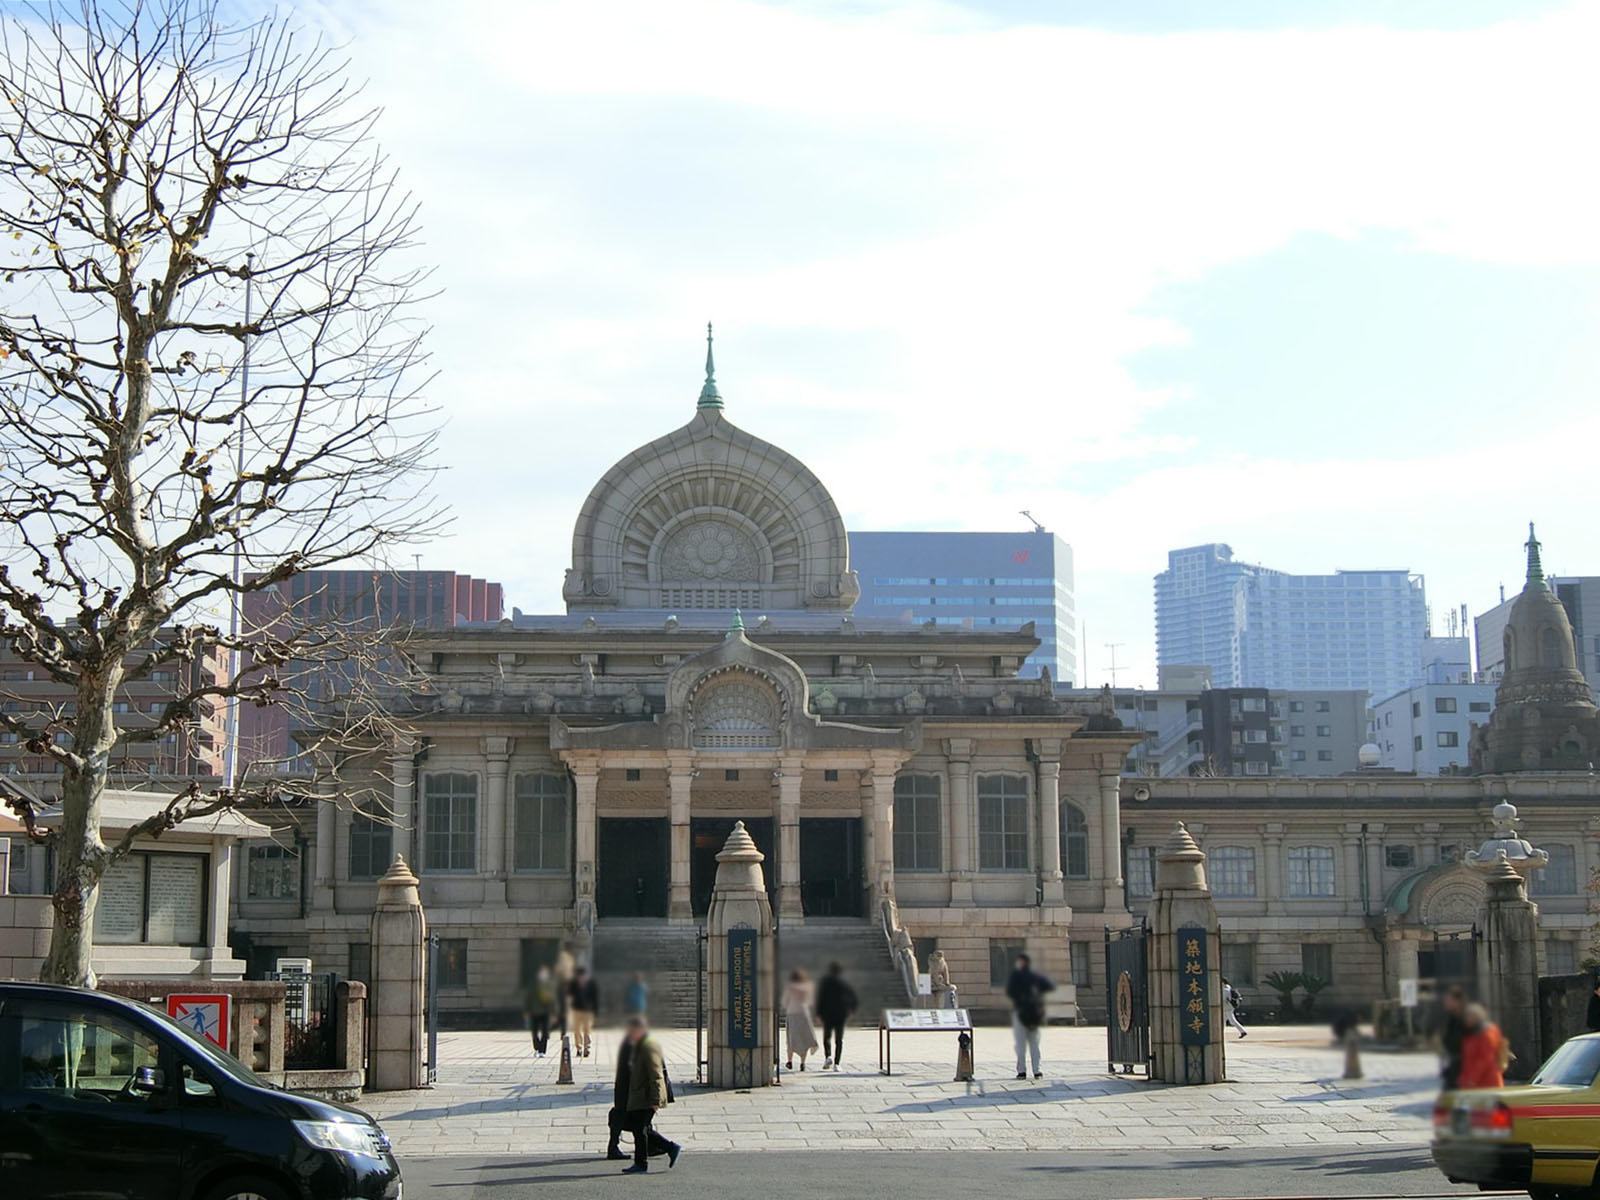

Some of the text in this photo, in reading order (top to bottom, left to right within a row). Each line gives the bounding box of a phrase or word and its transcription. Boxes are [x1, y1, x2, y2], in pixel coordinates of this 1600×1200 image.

[734, 947, 742, 1031] BUDDHIST TEMPLE
[743, 980, 752, 1039] HONGWANJI
[1185, 938, 1204, 1035] 築地本願寺
